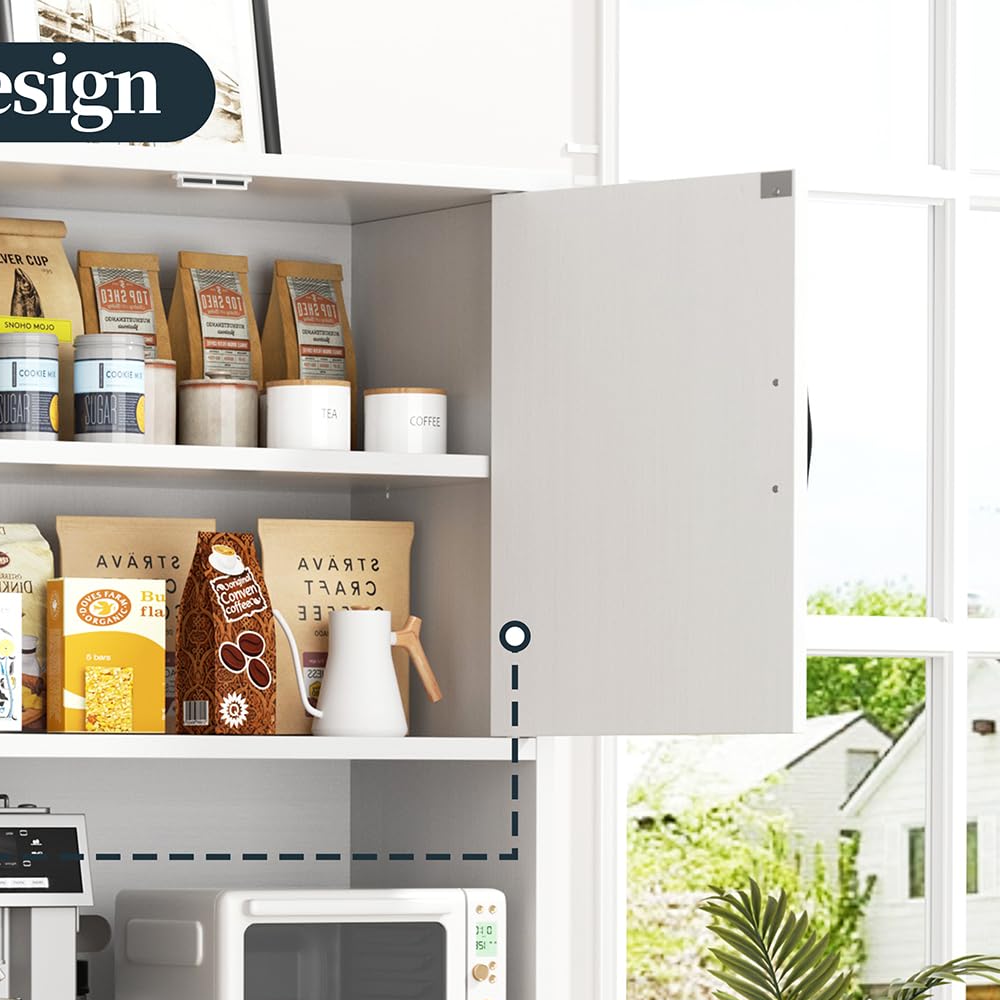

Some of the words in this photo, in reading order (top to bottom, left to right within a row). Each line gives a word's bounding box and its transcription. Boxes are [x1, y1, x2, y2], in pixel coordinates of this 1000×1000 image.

[26, 255, 48, 266] CUP
[4, 321, 32, 330] SNOHO
[33, 323, 55, 331] MOJO
[18, 369, 46, 377] COOKIE
[106, 370, 133, 379] COOKIE
[85, 395, 117, 425] SUGAR
[321, 408, 338, 419] TEA
[409, 416, 441, 427] COFFEE
[140, 591, 165, 602] Bu
[220, 584, 258, 605] Conven
[80, 591, 102, 614] DOVES
[104, 591, 128, 606] FARM
[226, 600, 252, 615] coffee
[84, 608, 128, 625] ORGANIC
[229, 703, 239, 717] Q
